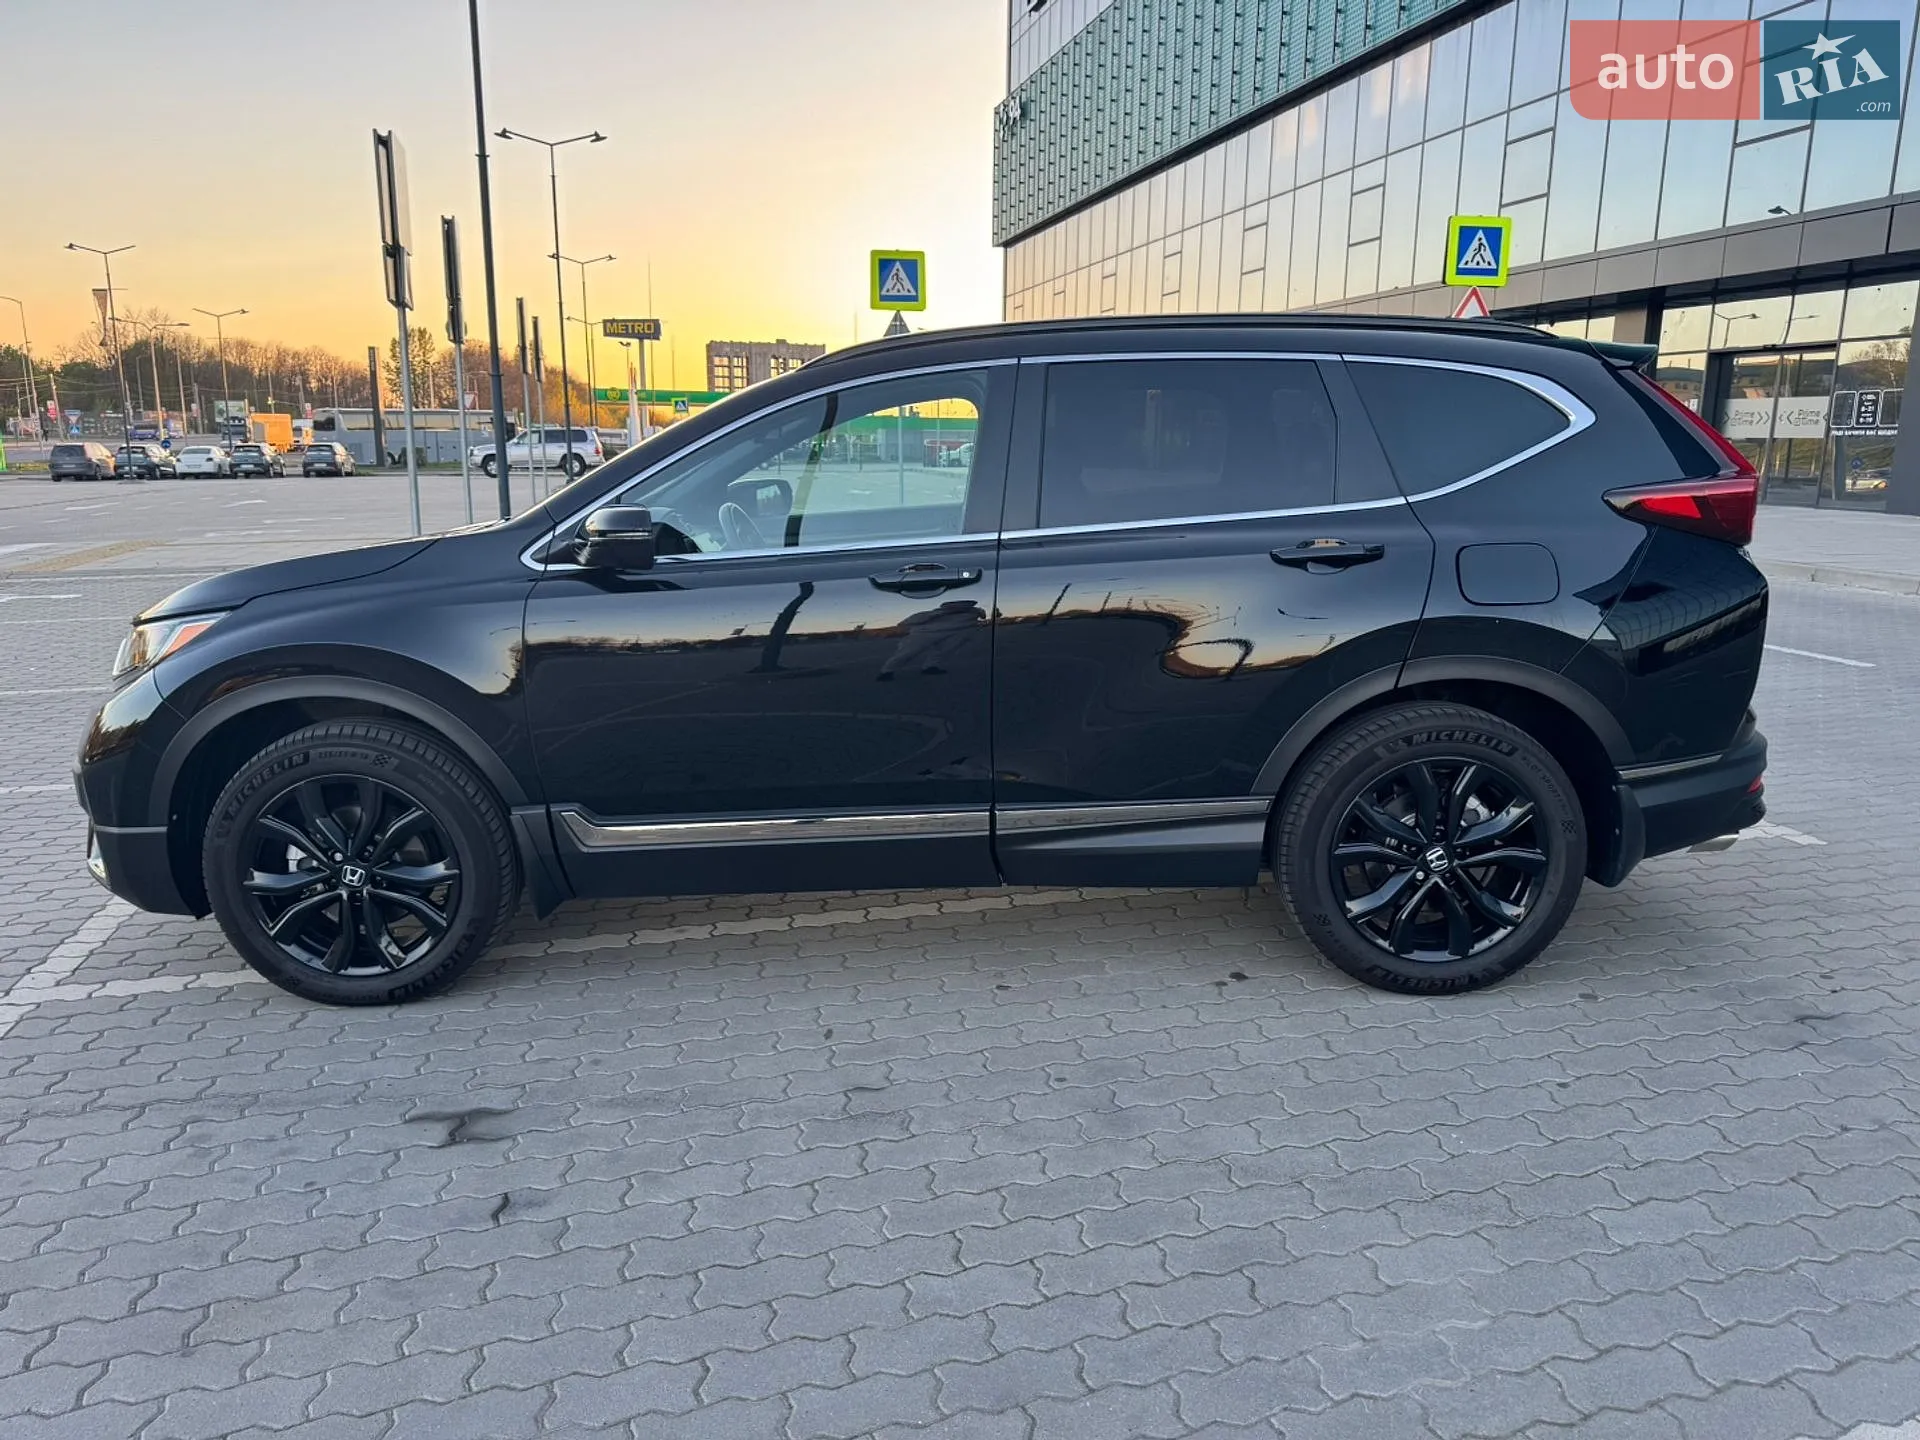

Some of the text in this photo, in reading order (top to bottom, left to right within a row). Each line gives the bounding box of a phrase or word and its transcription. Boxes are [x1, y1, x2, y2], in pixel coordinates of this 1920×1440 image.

[606, 322, 655, 334] METRO
[1412, 730, 1513, 753] MICHELIN
[228, 753, 305, 817] MICHELIN
